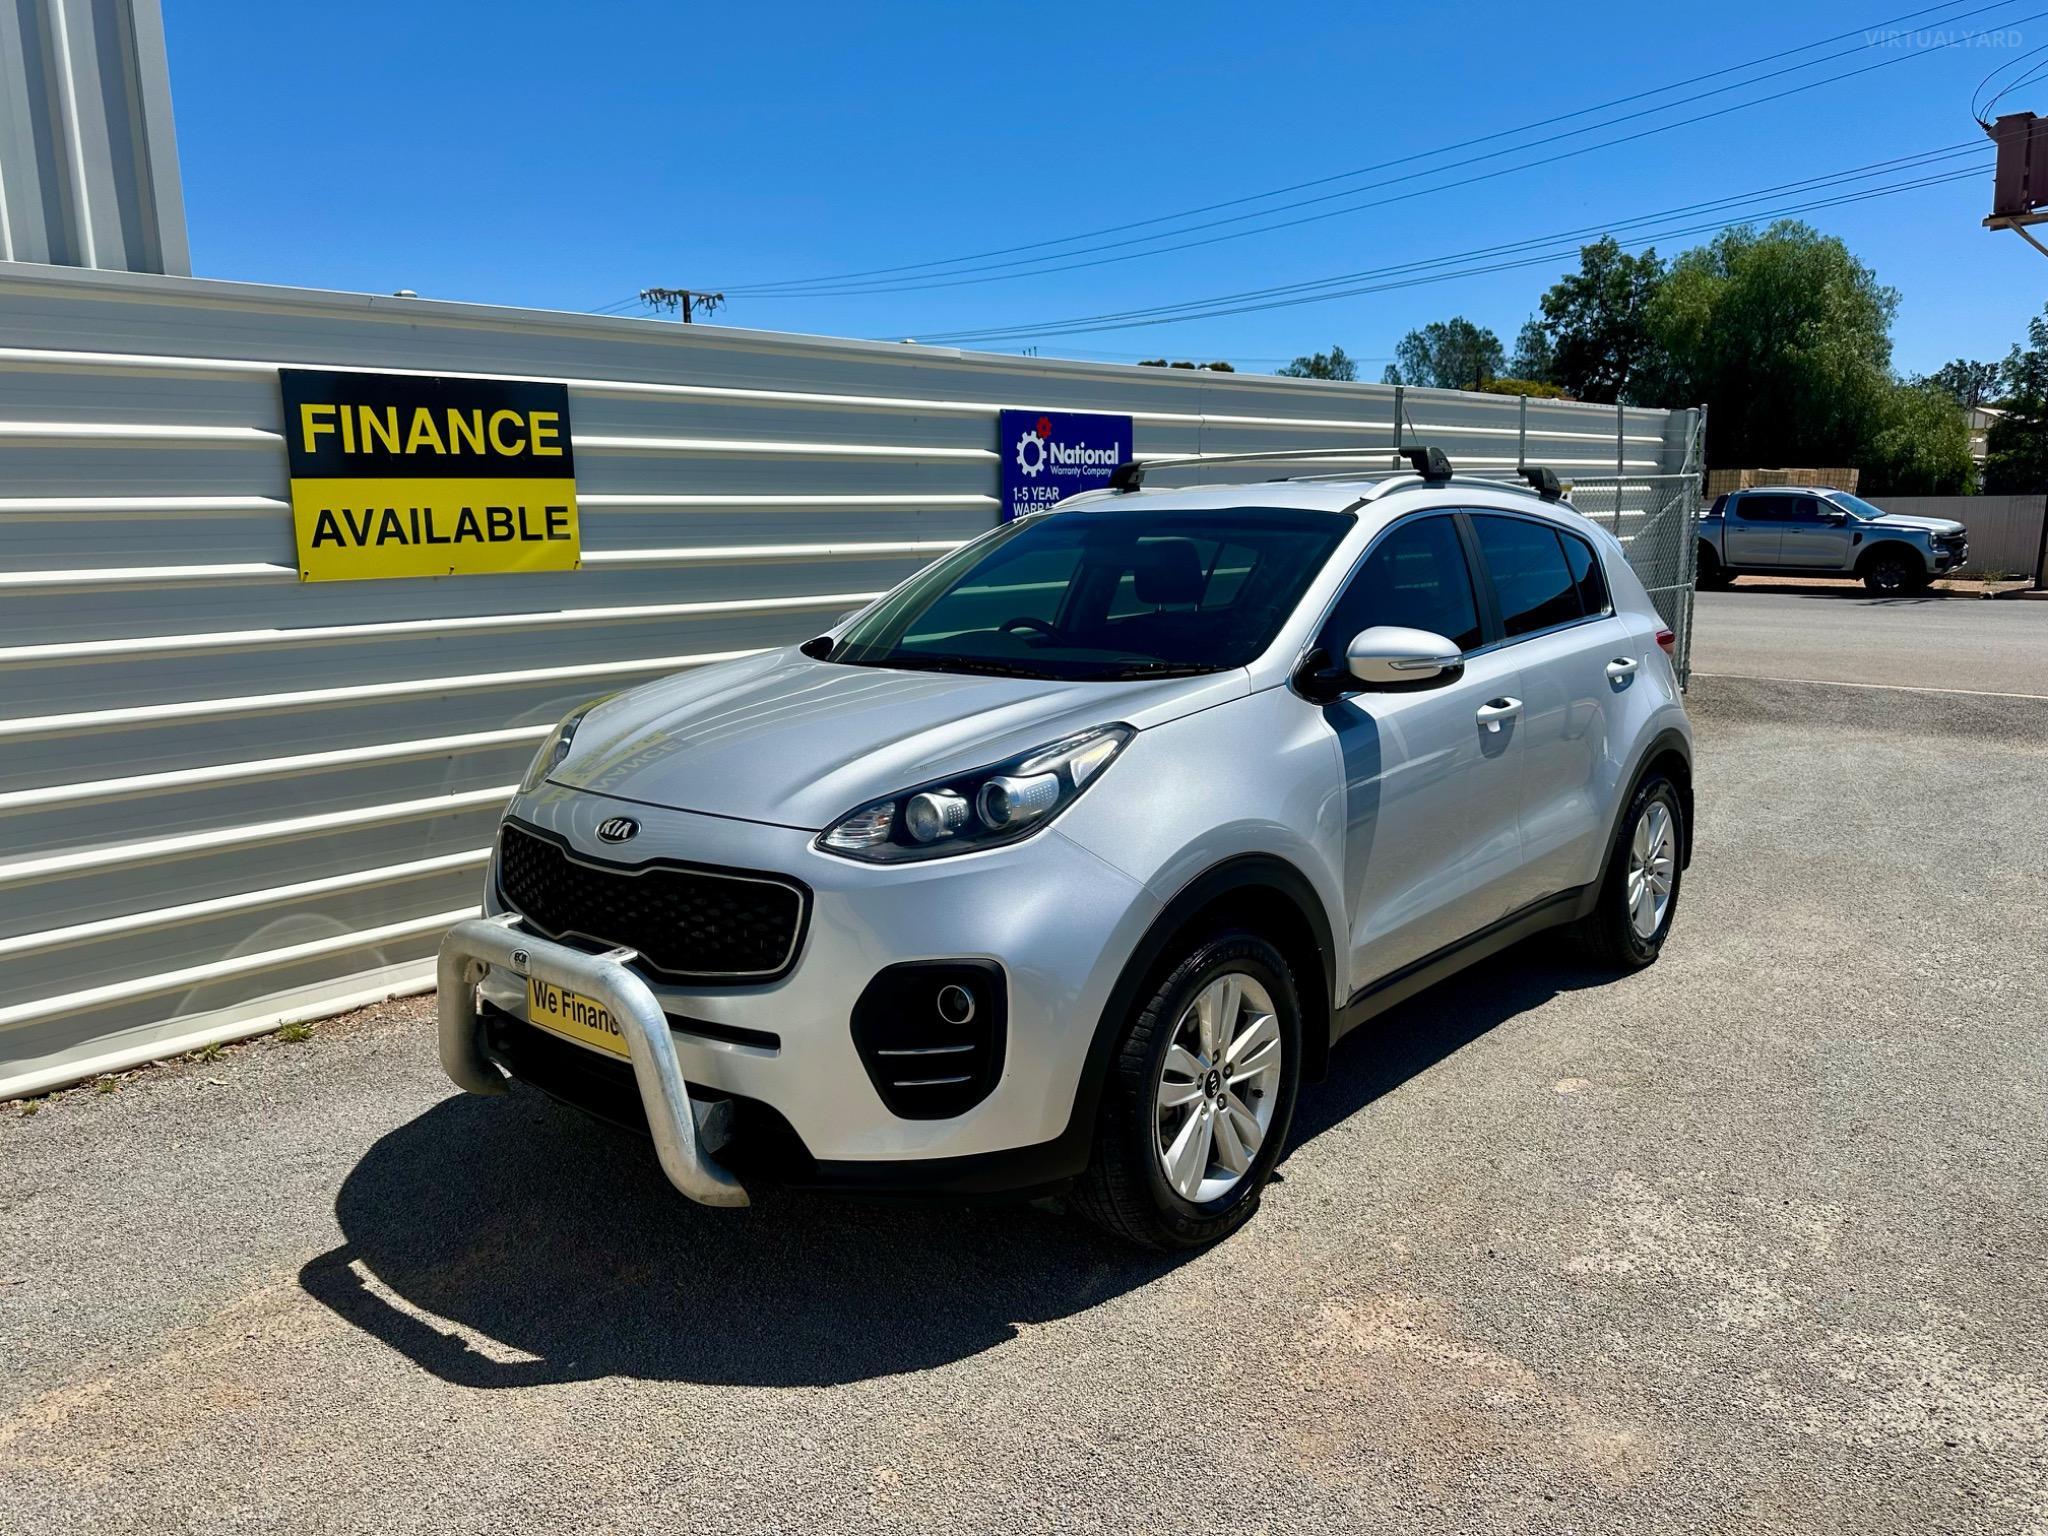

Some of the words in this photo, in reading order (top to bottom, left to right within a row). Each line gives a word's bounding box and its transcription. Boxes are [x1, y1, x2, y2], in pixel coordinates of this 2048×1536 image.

[300, 403, 563, 456] FINANCE
[1050, 441, 1119, 465] National
[1050, 466, 1081, 478] Warranty
[1082, 465, 1112, 478] Company
[1013, 487, 1029, 501] 1-5
[1031, 486, 1060, 500] YEAR
[311, 506, 572, 548] AVAILABLE
[599, 818, 634, 839] KIA
[532, 979, 558, 1014] We
